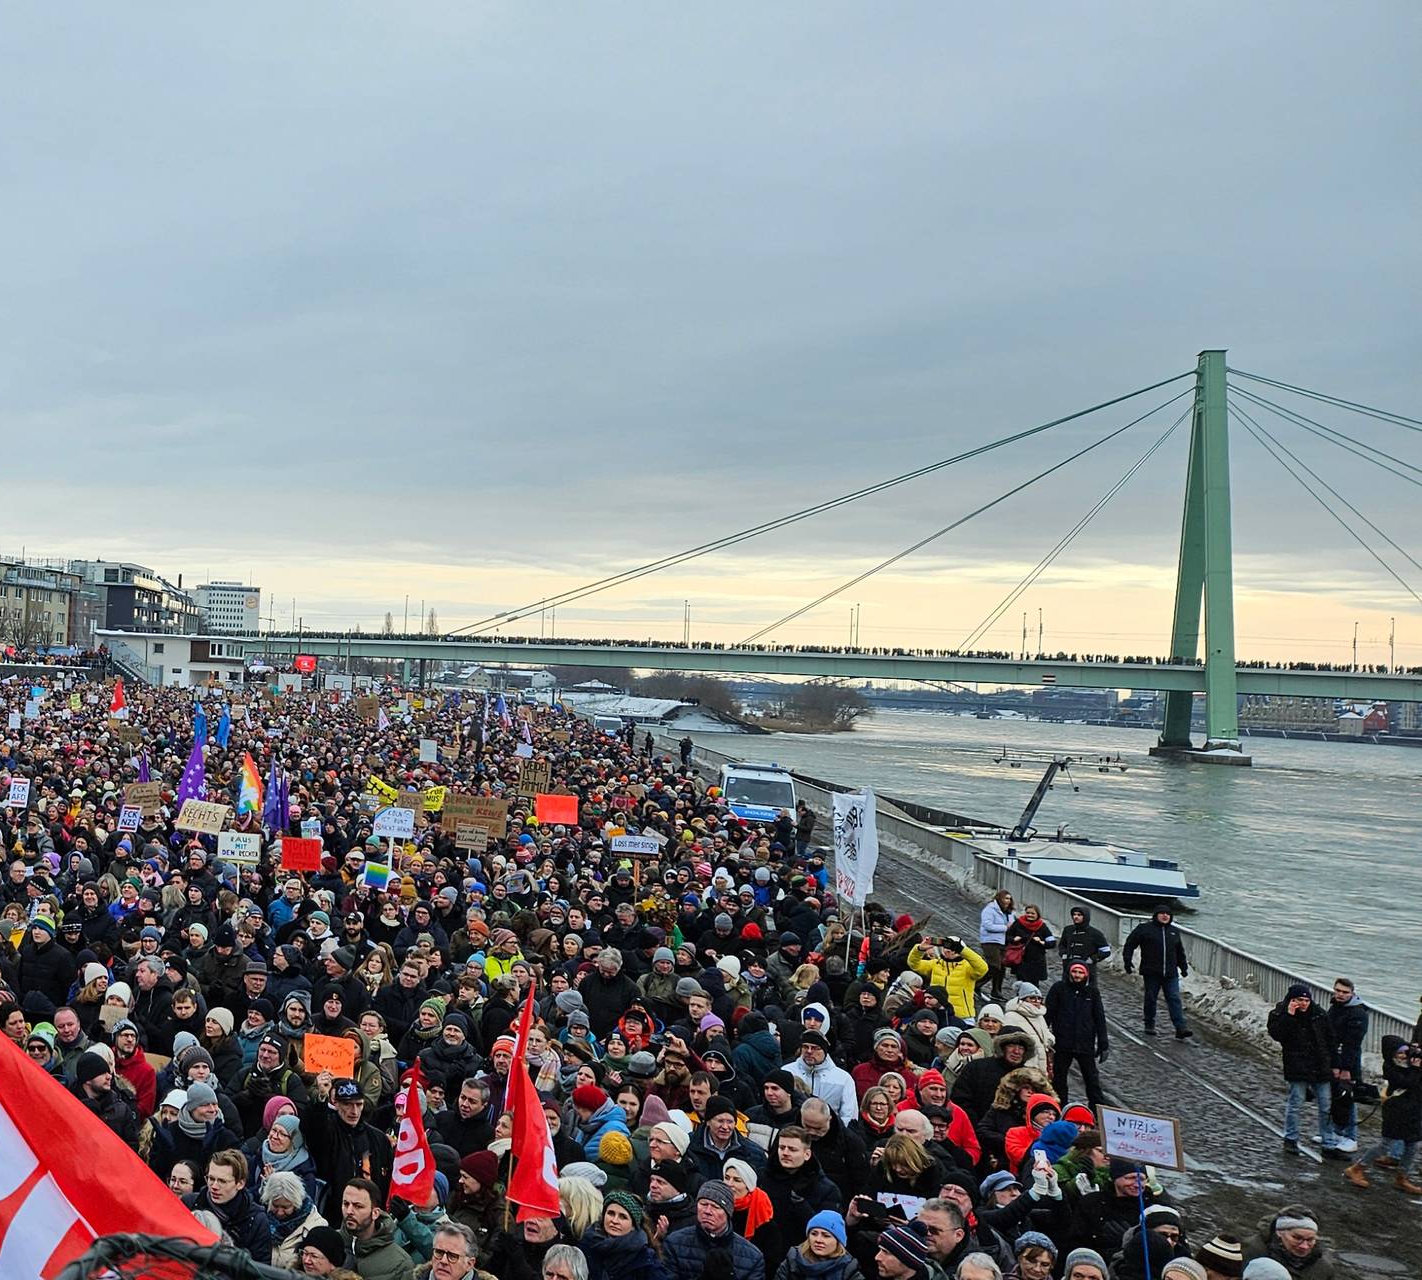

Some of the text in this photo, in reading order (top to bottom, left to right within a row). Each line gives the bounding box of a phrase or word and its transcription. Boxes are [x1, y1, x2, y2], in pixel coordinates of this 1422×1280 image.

[123, 810, 138, 819] FCK
[182, 808, 219, 823] RECHTS
[121, 818, 136, 827] NZS
[629, 840, 640, 848] mer
[641, 840, 658, 852] singe
